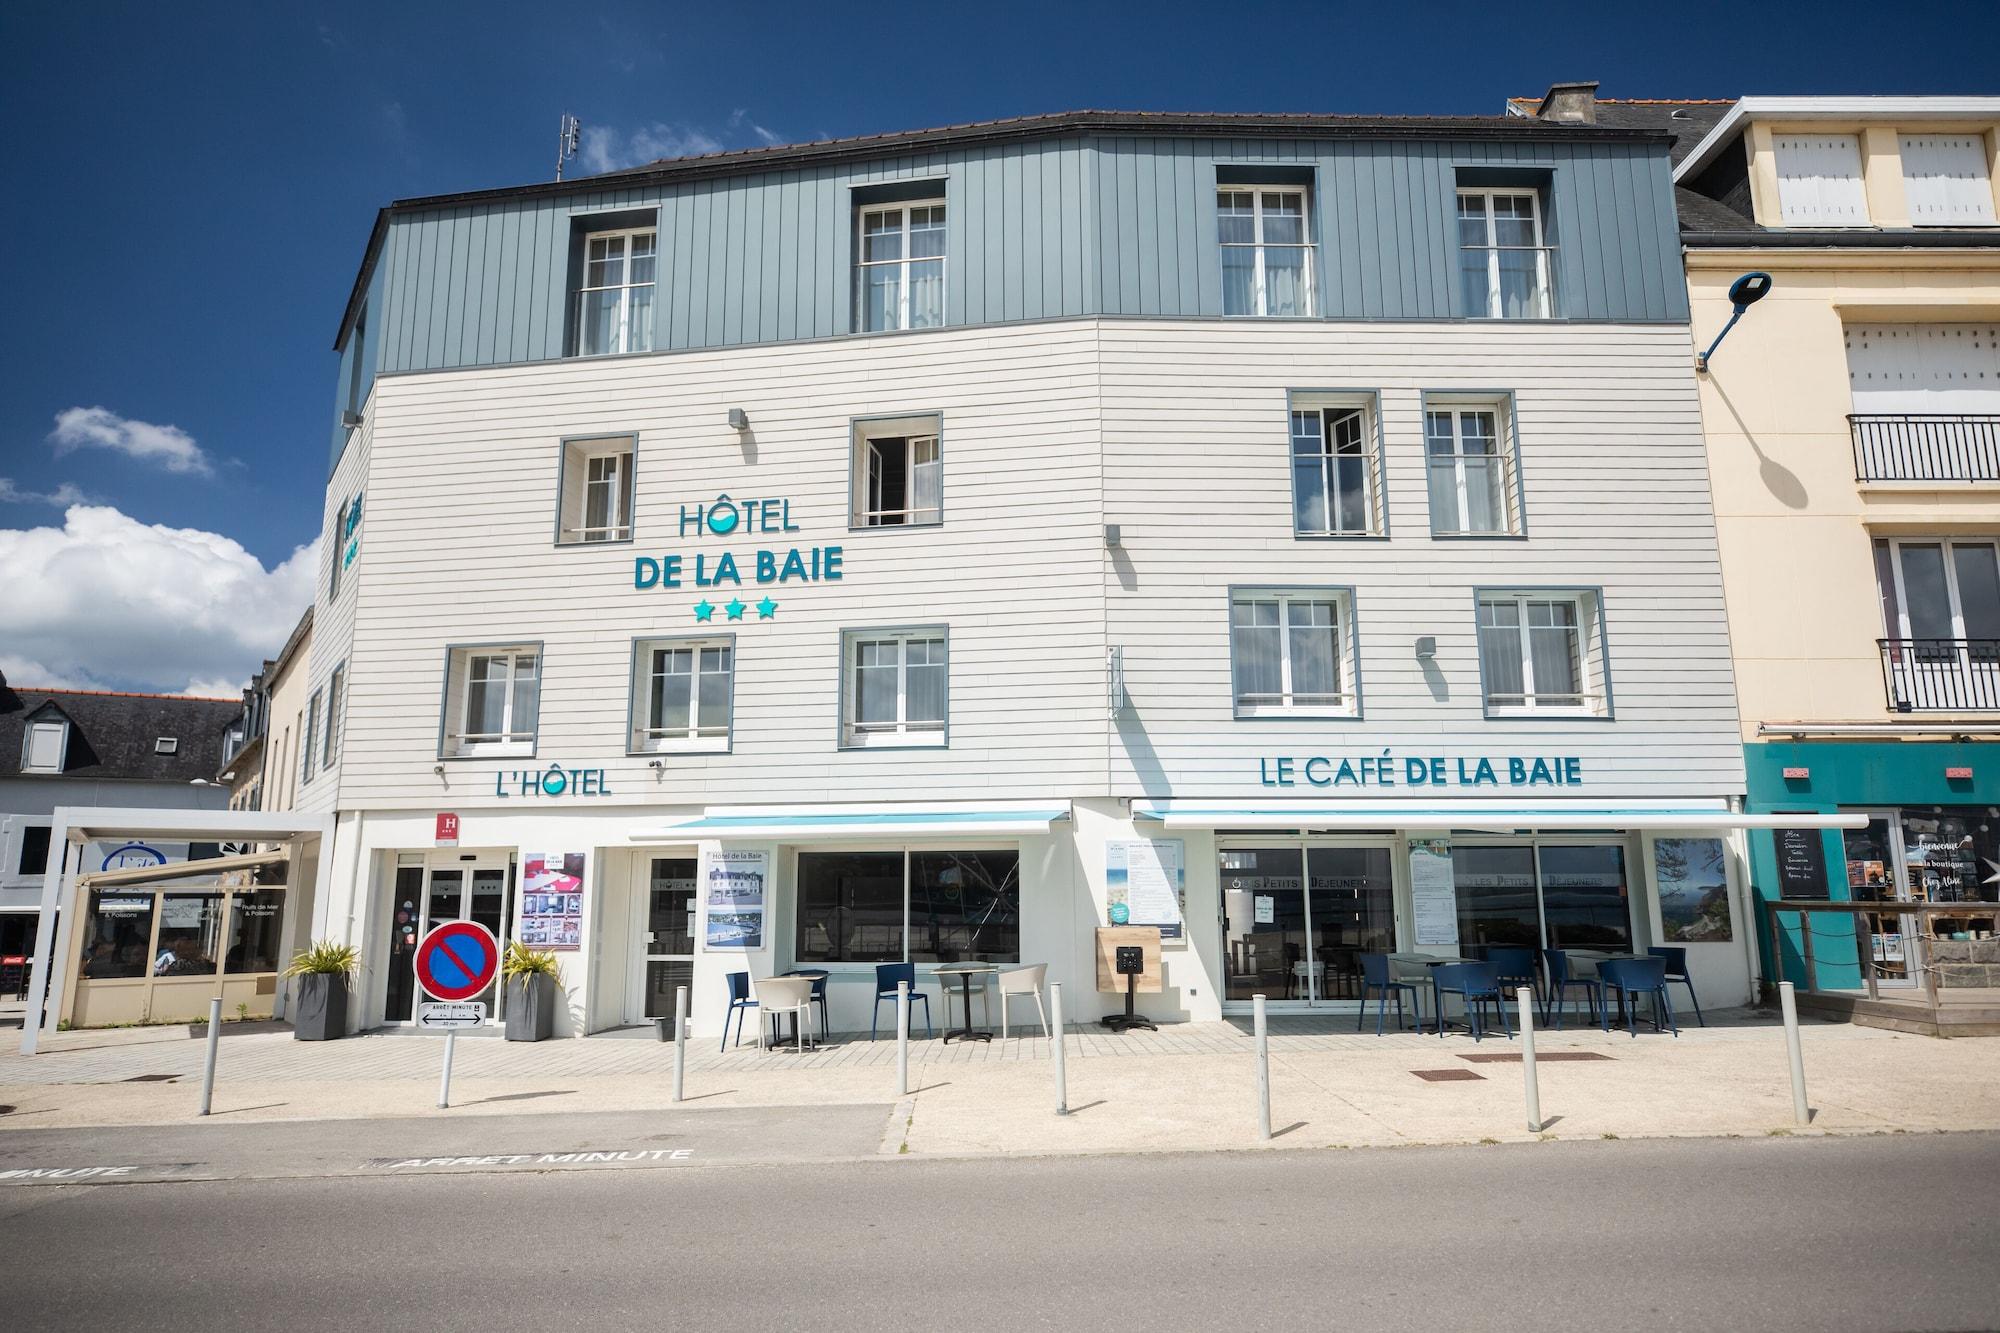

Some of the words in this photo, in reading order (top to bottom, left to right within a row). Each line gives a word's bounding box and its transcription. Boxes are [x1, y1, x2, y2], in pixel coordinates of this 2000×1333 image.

[680, 493, 800, 538] HÔTEL
[635, 555, 683, 589] DE
[696, 552, 742, 586] LA
[756, 546, 843, 583] BAIE
[497, 763, 612, 797] L'HÔTEL
[1261, 757, 1294, 786] LE
[1305, 748, 1396, 786] CAFÉ
[1405, 757, 1448, 786] DE
[1458, 757, 1499, 786] LA
[1509, 757, 1582, 786] BAIE
[445, 817, 457, 829] H
[536, 1149, 694, 1163] MINUTE
